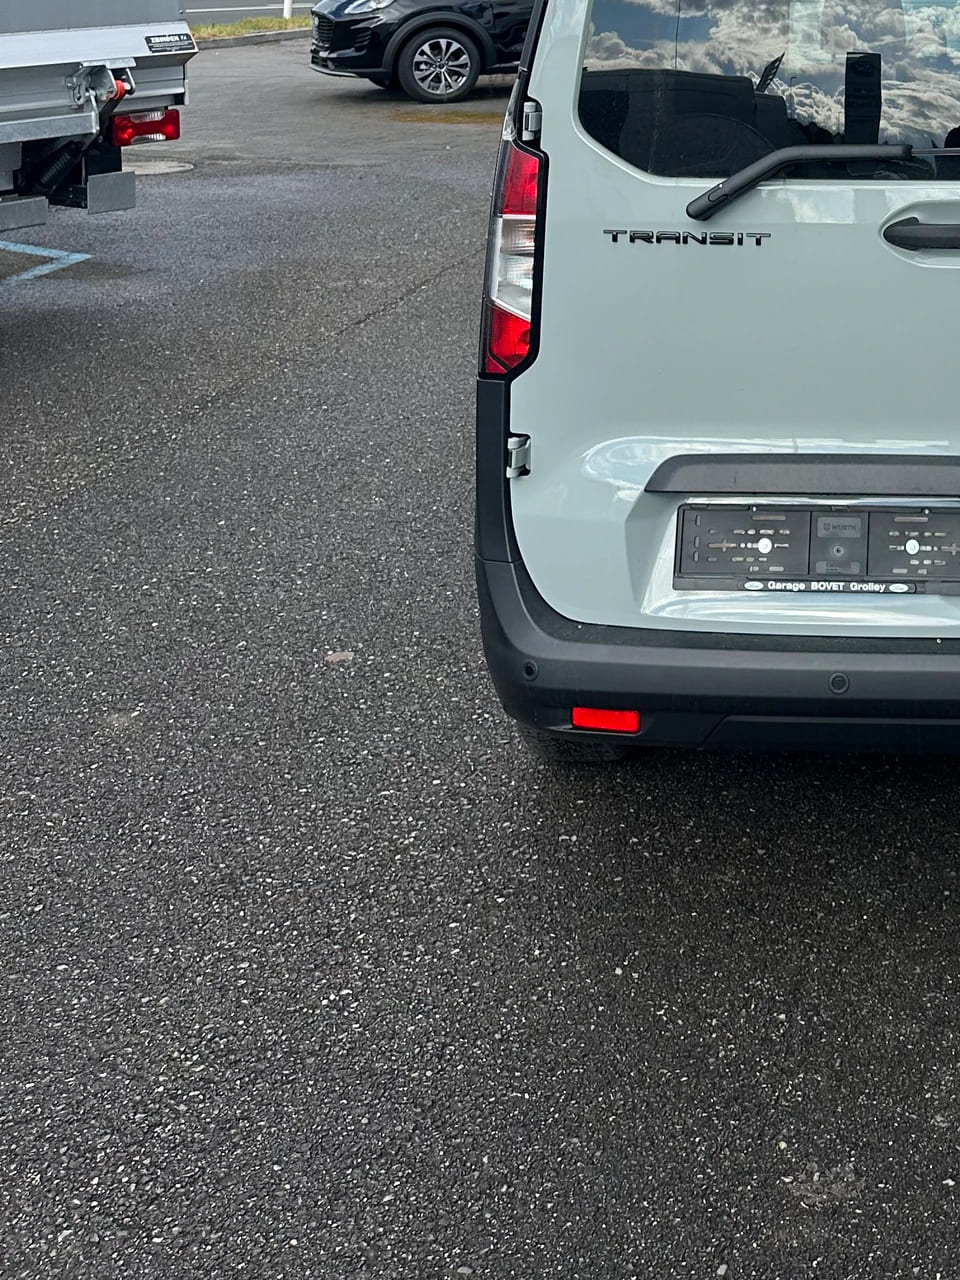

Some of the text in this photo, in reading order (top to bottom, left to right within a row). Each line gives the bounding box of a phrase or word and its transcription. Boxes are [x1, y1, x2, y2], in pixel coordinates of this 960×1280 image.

[603, 230, 771, 246] TRANSIT
[768, 581, 805, 591] Garage
[811, 581, 845, 590] BOVET
[850, 582, 886, 592] Grolley
